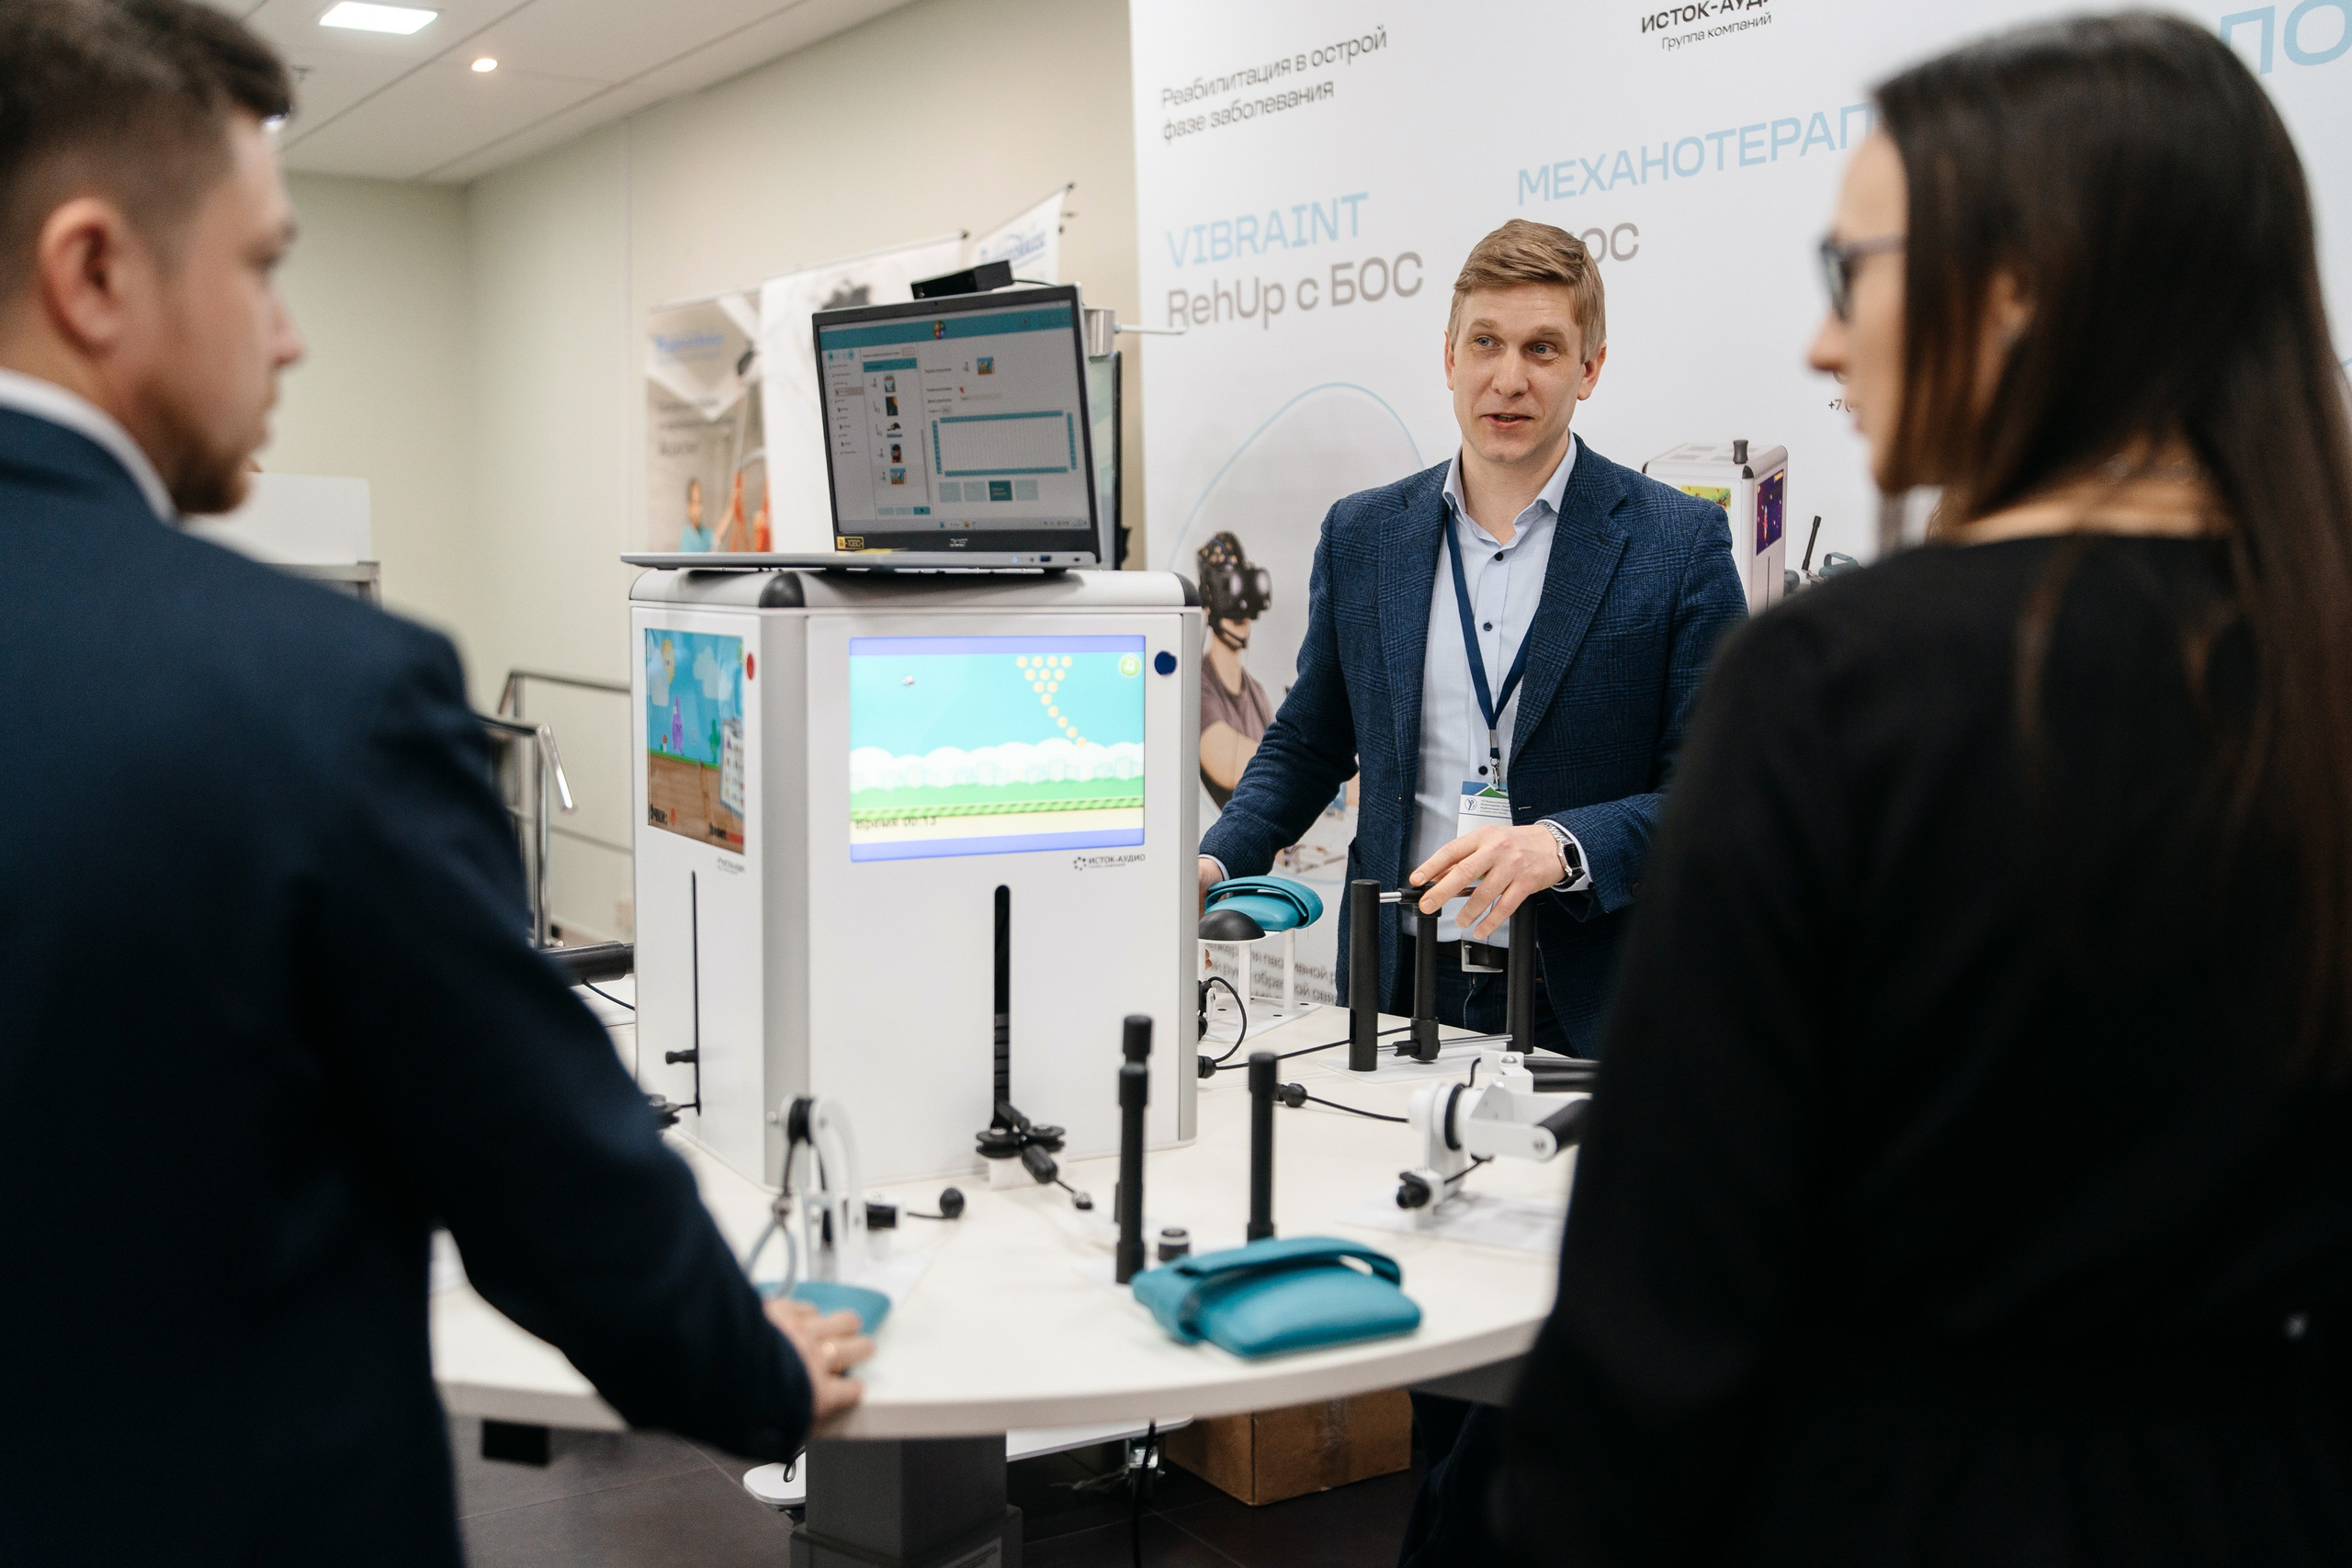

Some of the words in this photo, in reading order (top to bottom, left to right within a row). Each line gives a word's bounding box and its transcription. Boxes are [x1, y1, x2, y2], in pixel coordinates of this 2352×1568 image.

[1640, 0, 1773, 34] ИСТОК-АУД
[1661, 30, 1706, 52] Группа
[1707, 11, 1772, 39] компаний
[1161, 57, 1293, 108] Реабилитация
[1295, 53, 1308, 72] в
[1311, 24, 1388, 69] острой
[1161, 117, 1207, 145] фазе
[1210, 80, 1334, 130] заболевания
[1166, 191, 1369, 269] VIBRAINT
[1570, 221, 1640, 265] ОС
[1166, 275, 1285, 331] RehUp
[1295, 276, 1320, 311] с
[1330, 250, 1424, 308] БОС
[1828, 398, 1843, 411] +7
[1089, 854, 1147, 864] ИСТОК-АУДИО
